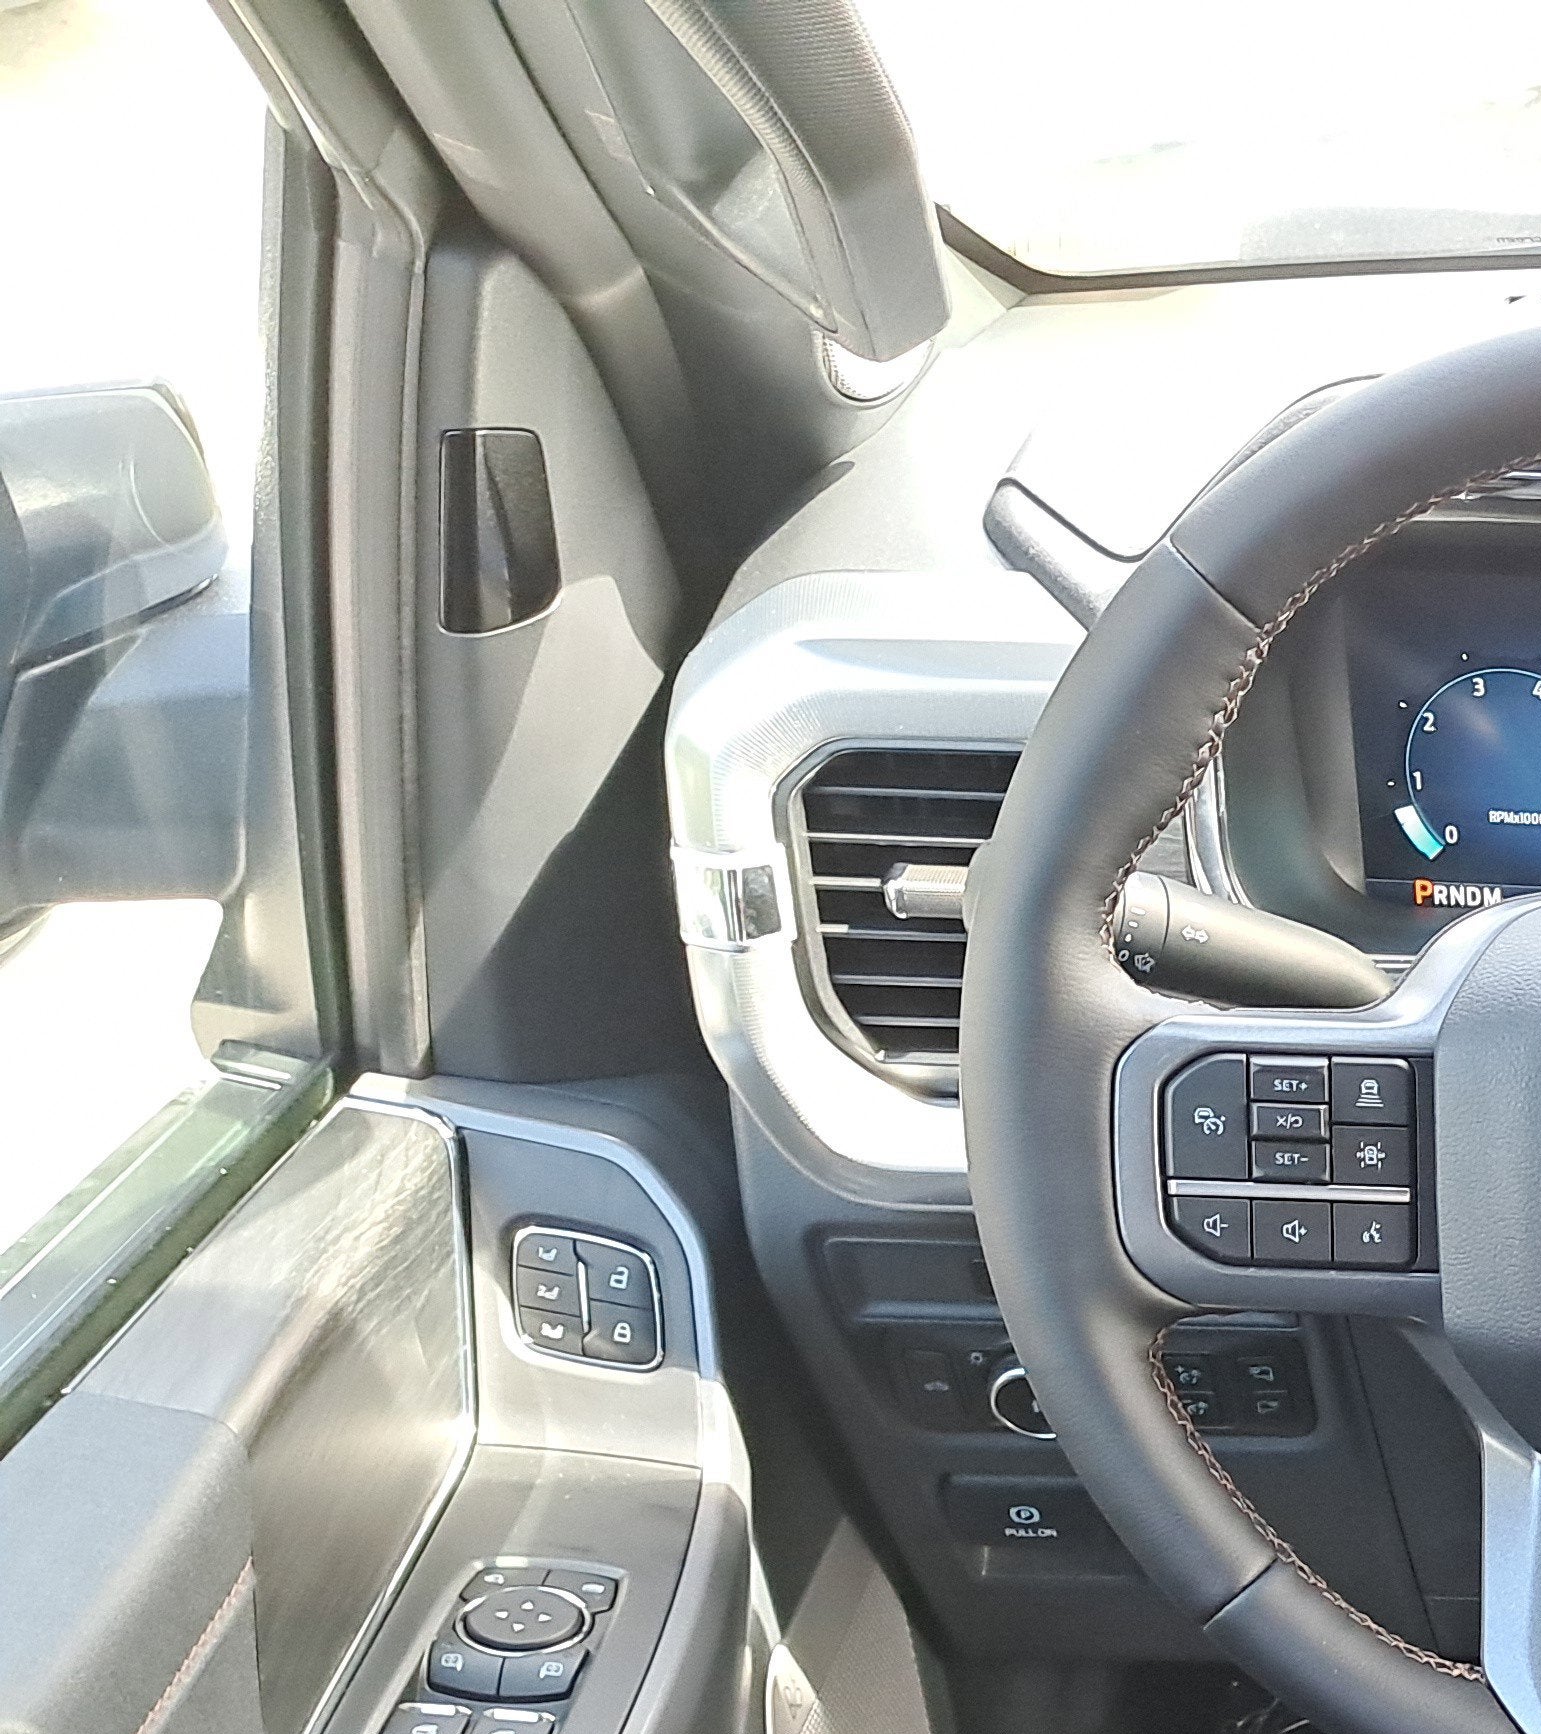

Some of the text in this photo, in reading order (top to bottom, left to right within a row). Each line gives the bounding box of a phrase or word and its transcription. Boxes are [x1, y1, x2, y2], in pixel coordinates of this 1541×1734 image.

[1472, 677, 1485, 697] 3
[1423, 712, 1436, 732] 2
[1413, 771, 1422, 790] 1
[1445, 825, 1458, 844] 0
